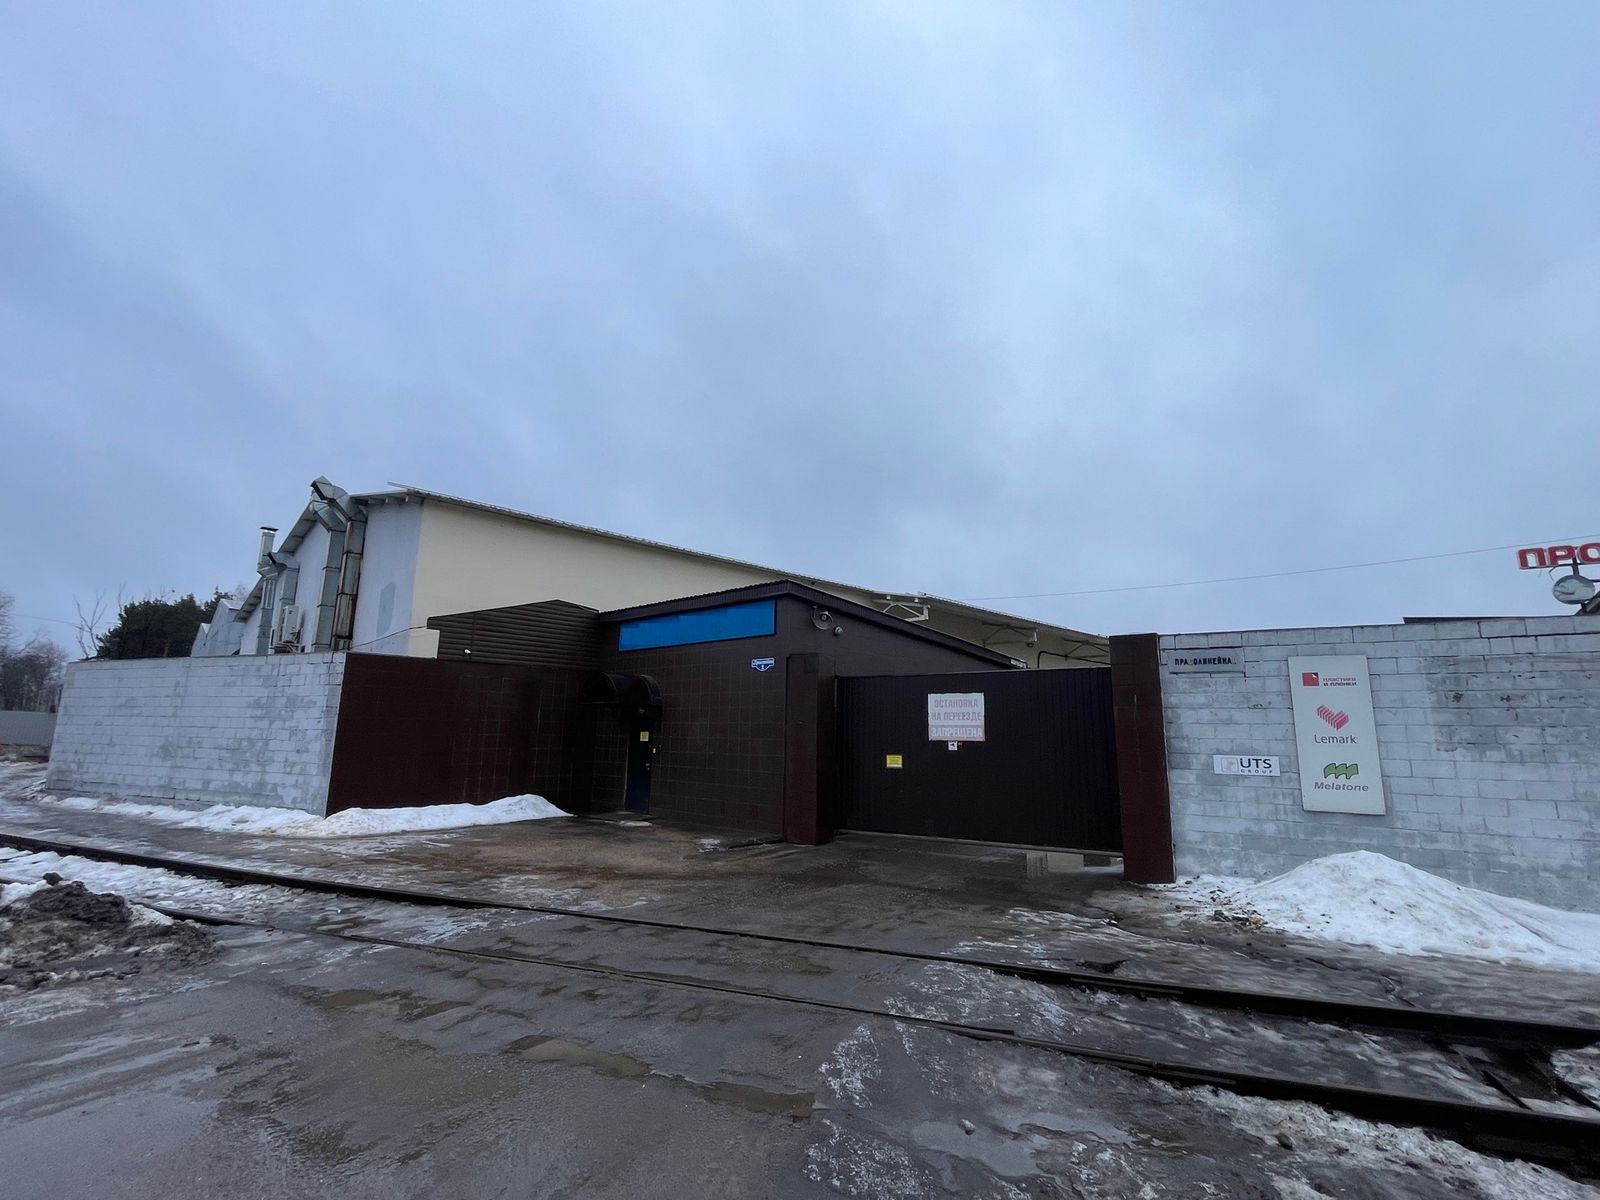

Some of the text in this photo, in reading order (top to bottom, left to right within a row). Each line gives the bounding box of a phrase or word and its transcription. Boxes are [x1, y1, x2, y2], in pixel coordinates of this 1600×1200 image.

[1174, 655, 1237, 666] ПРАОЛИНЕЙНА
[934, 699, 978, 708] ОСТАНОВКА
[931, 711, 983, 721] НА ПЕРЕЕЗДЕ
[931, 727, 982, 737] ЗАПРЕЩЕНА
[1314, 734, 1358, 744] Lemark
[1239, 758, 1273, 769] UTS
[1314, 781, 1369, 792] Melatone
